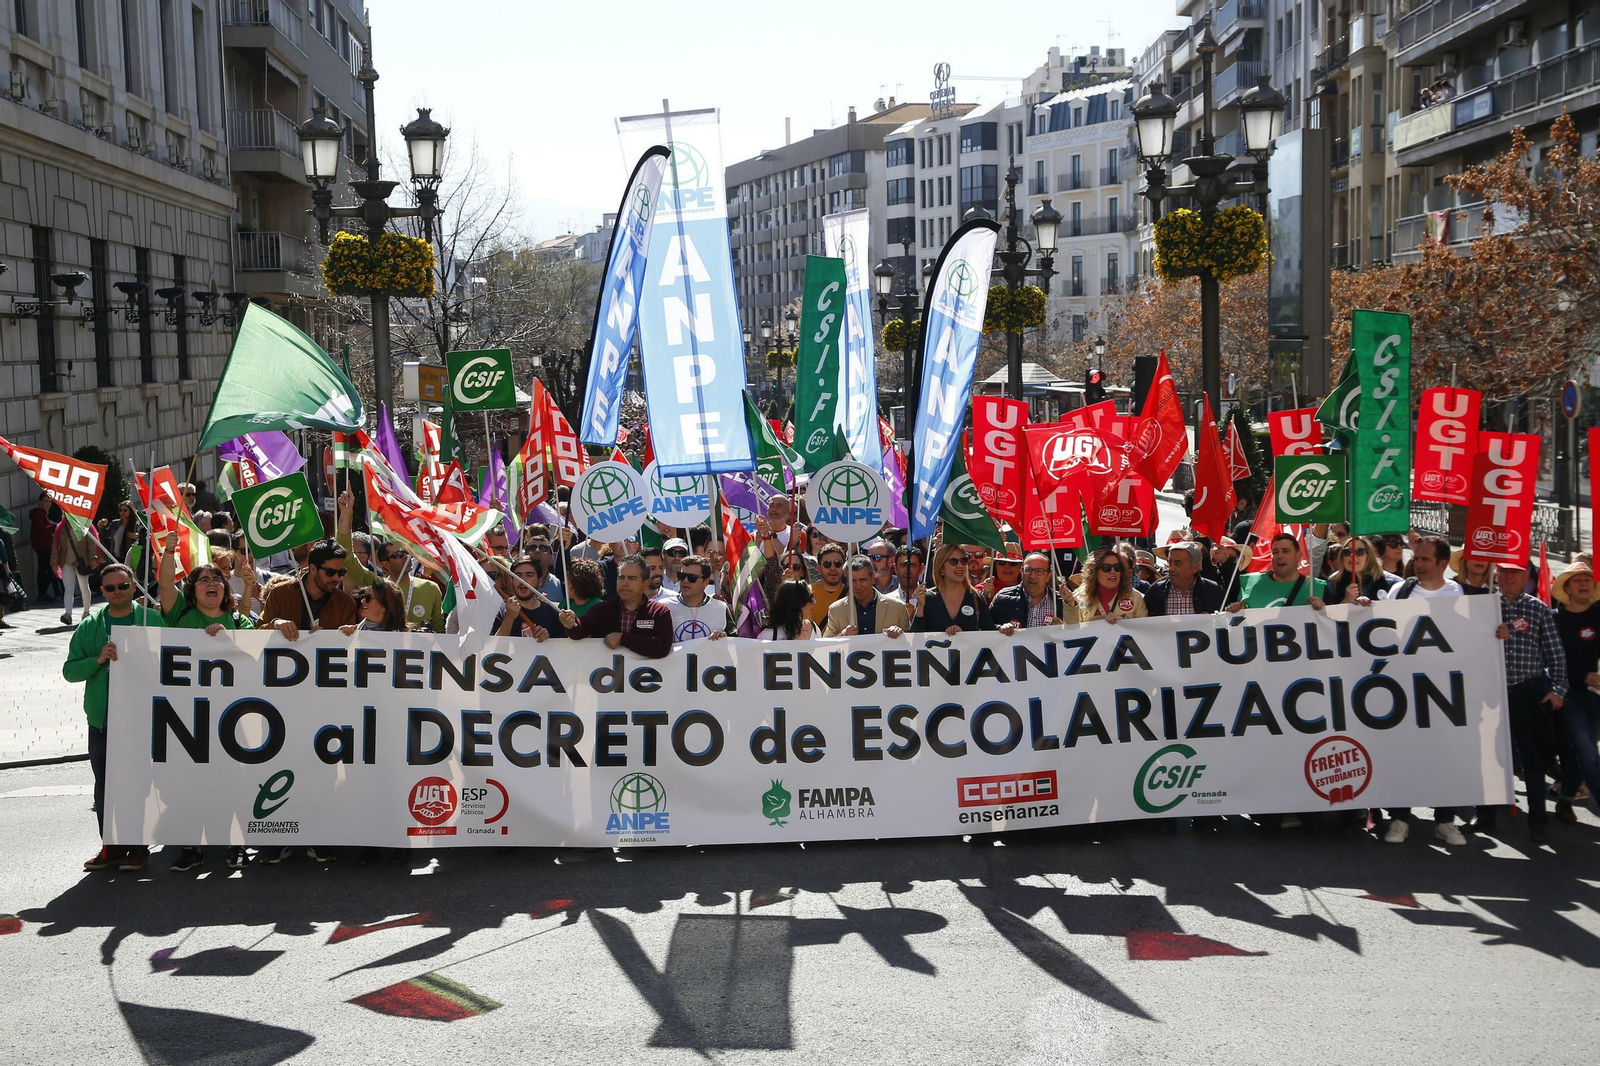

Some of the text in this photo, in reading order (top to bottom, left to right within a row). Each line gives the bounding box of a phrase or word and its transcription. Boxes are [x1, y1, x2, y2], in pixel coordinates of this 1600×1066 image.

[658, 234, 726, 455] ANPE
[463, 369, 506, 388] CSIF
[915, 325, 959, 528] ANPE
[1429, 393, 1468, 470] UGT
[984, 402, 1018, 486] UGT
[1290, 479, 1337, 499] CSIF
[1482, 439, 1526, 526] UGT
[259, 498, 303, 530] CSIF
[587, 494, 648, 535] ANPE
[651, 493, 710, 515] ANPE
[814, 506, 883, 525] ANPE
[160, 616, 1453, 694] En DEFENSA de la ENSEÑANZA PÚBLICA
[151, 659, 1468, 768] NO al DECRETO de ESCOLARIZACIÓN
[1311, 747, 1360, 773] FRENTE
[1148, 765, 1207, 790] CSIF
[1316, 766, 1366, 787] ESTUDIANTES
[415, 786, 451, 804] UGT
[799, 787, 875, 808] FAMPA
[606, 812, 670, 830] ANPE
[800, 808, 874, 820] ALHAMBRA
[959, 804, 1059, 823] enseñanza
